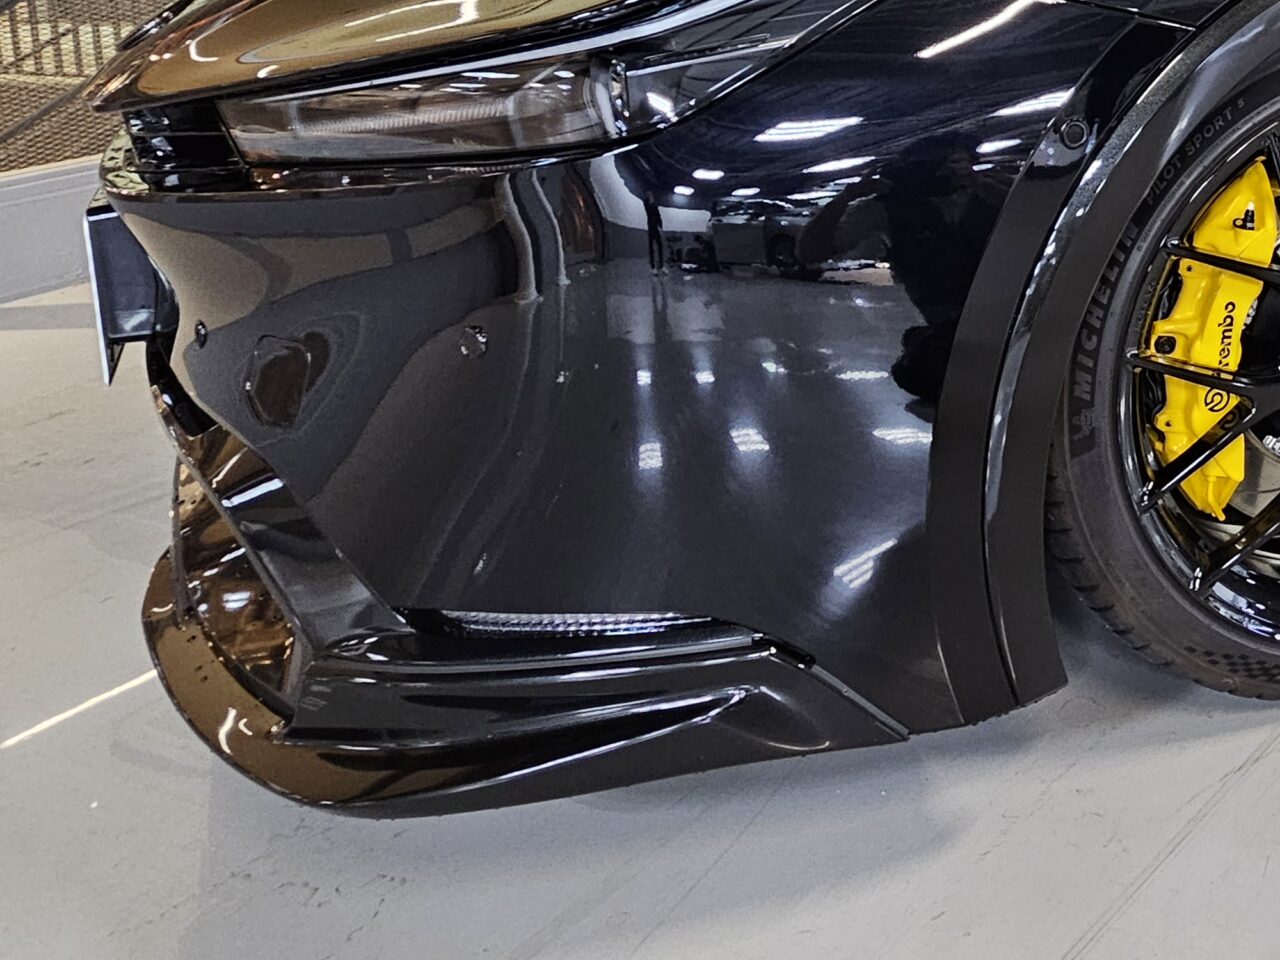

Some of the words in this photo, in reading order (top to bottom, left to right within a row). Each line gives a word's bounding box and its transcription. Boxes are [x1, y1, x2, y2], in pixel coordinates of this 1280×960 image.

[1146, 158, 1183, 206] PILOT
[1184, 106, 1237, 157] SPORT
[1237, 97, 1246, 109] 5
[1073, 220, 1140, 402] MICHELIN
